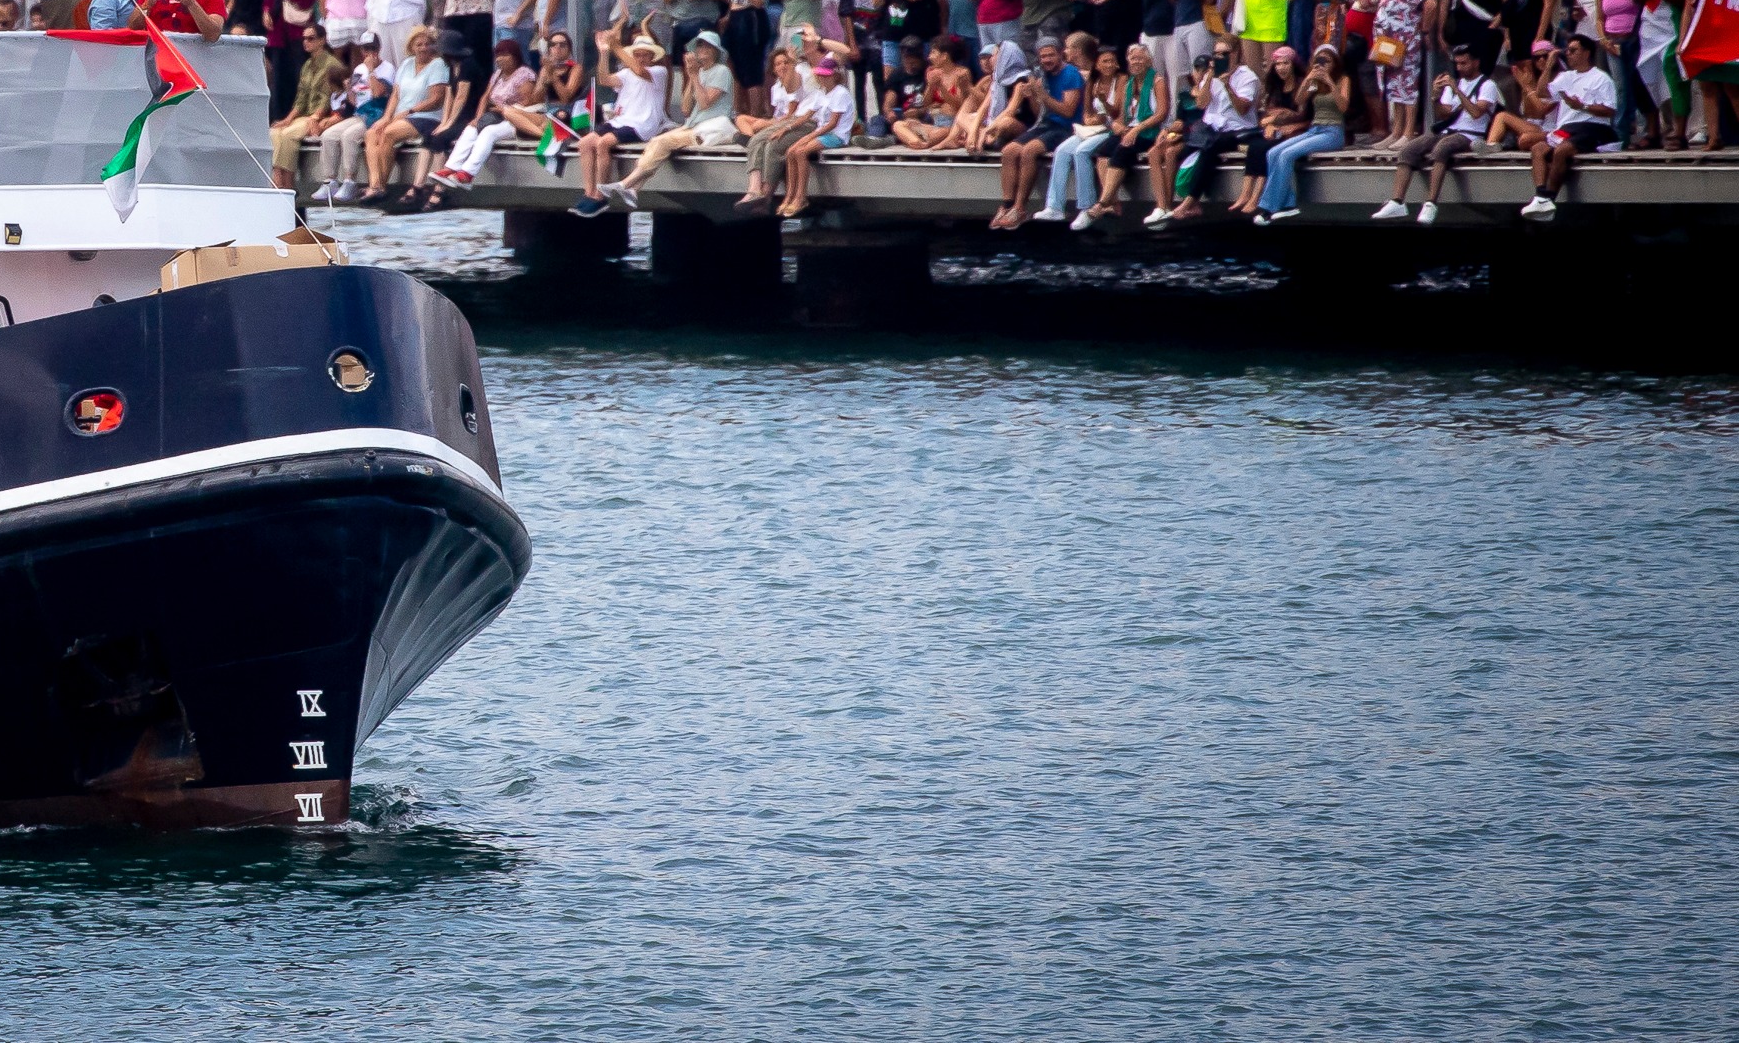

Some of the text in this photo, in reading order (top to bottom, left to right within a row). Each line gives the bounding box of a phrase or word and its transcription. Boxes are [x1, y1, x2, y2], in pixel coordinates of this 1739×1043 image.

[296, 690, 327, 717] IX
[289, 741, 328, 769] VIII
[294, 793, 325, 822] VII
